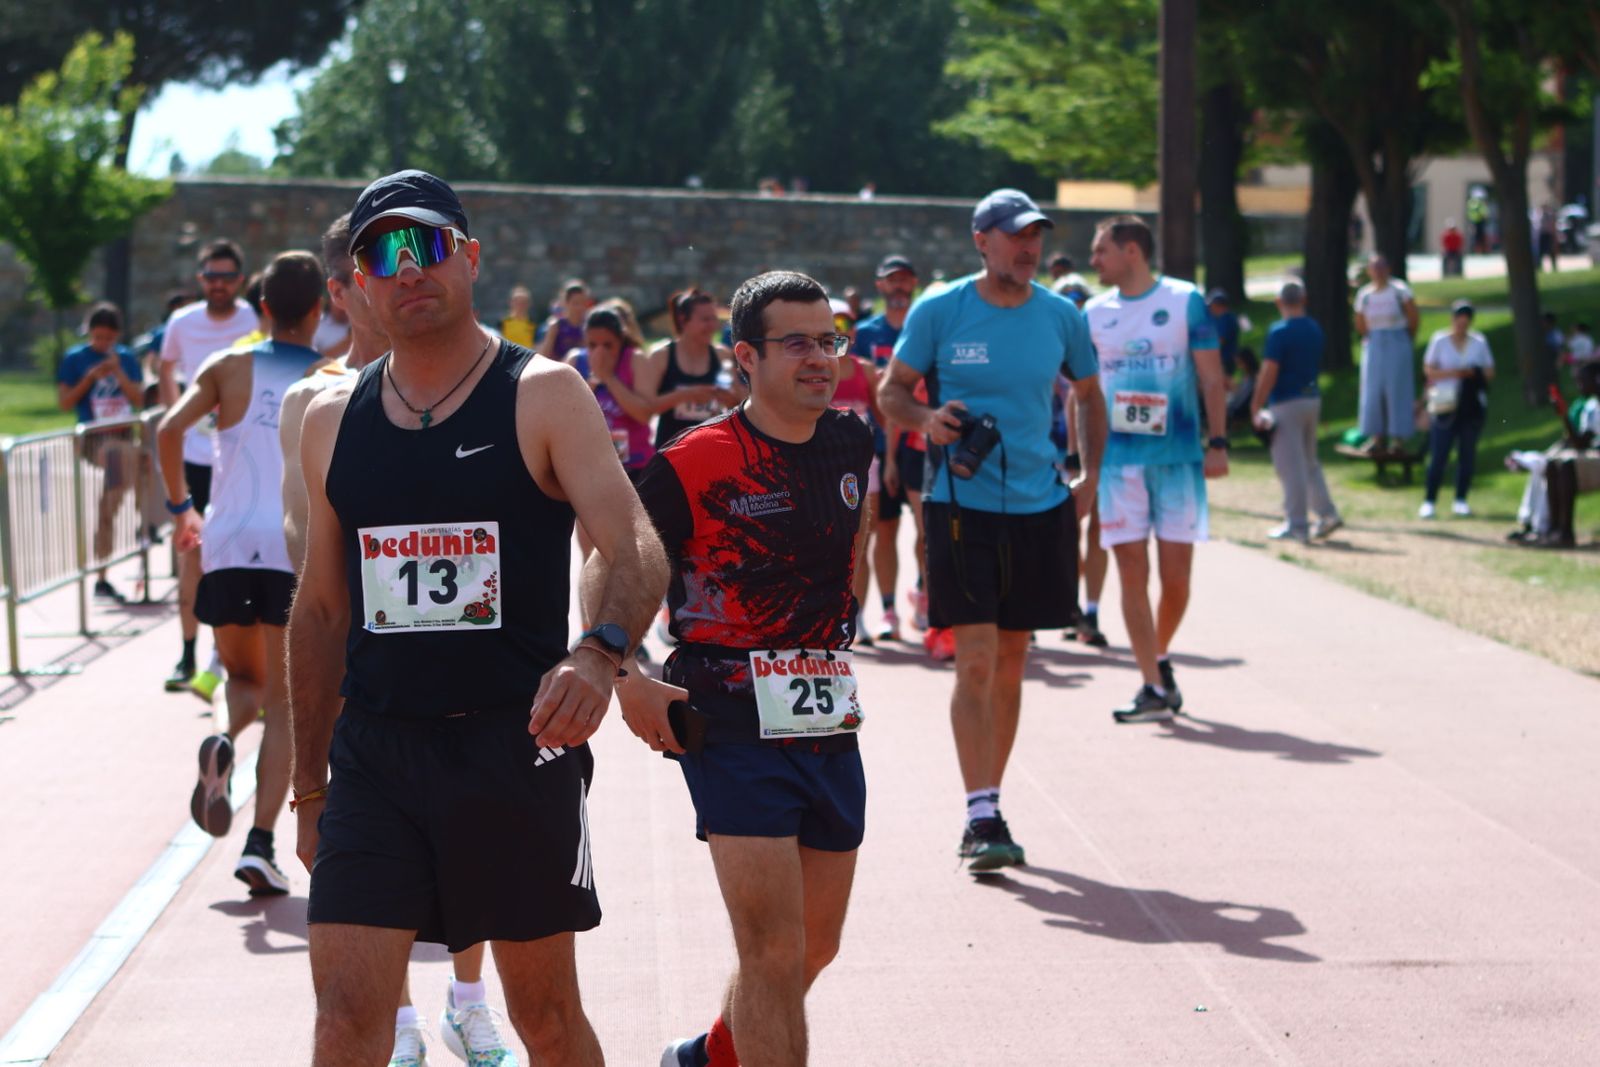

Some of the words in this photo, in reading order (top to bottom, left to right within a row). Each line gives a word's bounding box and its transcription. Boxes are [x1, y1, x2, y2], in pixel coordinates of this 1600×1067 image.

[1102, 353, 1180, 373] NFINITY
[1126, 405, 1151, 423] 85
[362, 529, 496, 560] bedunia
[398, 558, 459, 606] 13
[753, 653, 853, 678] bedunia
[789, 677, 835, 716] 25
